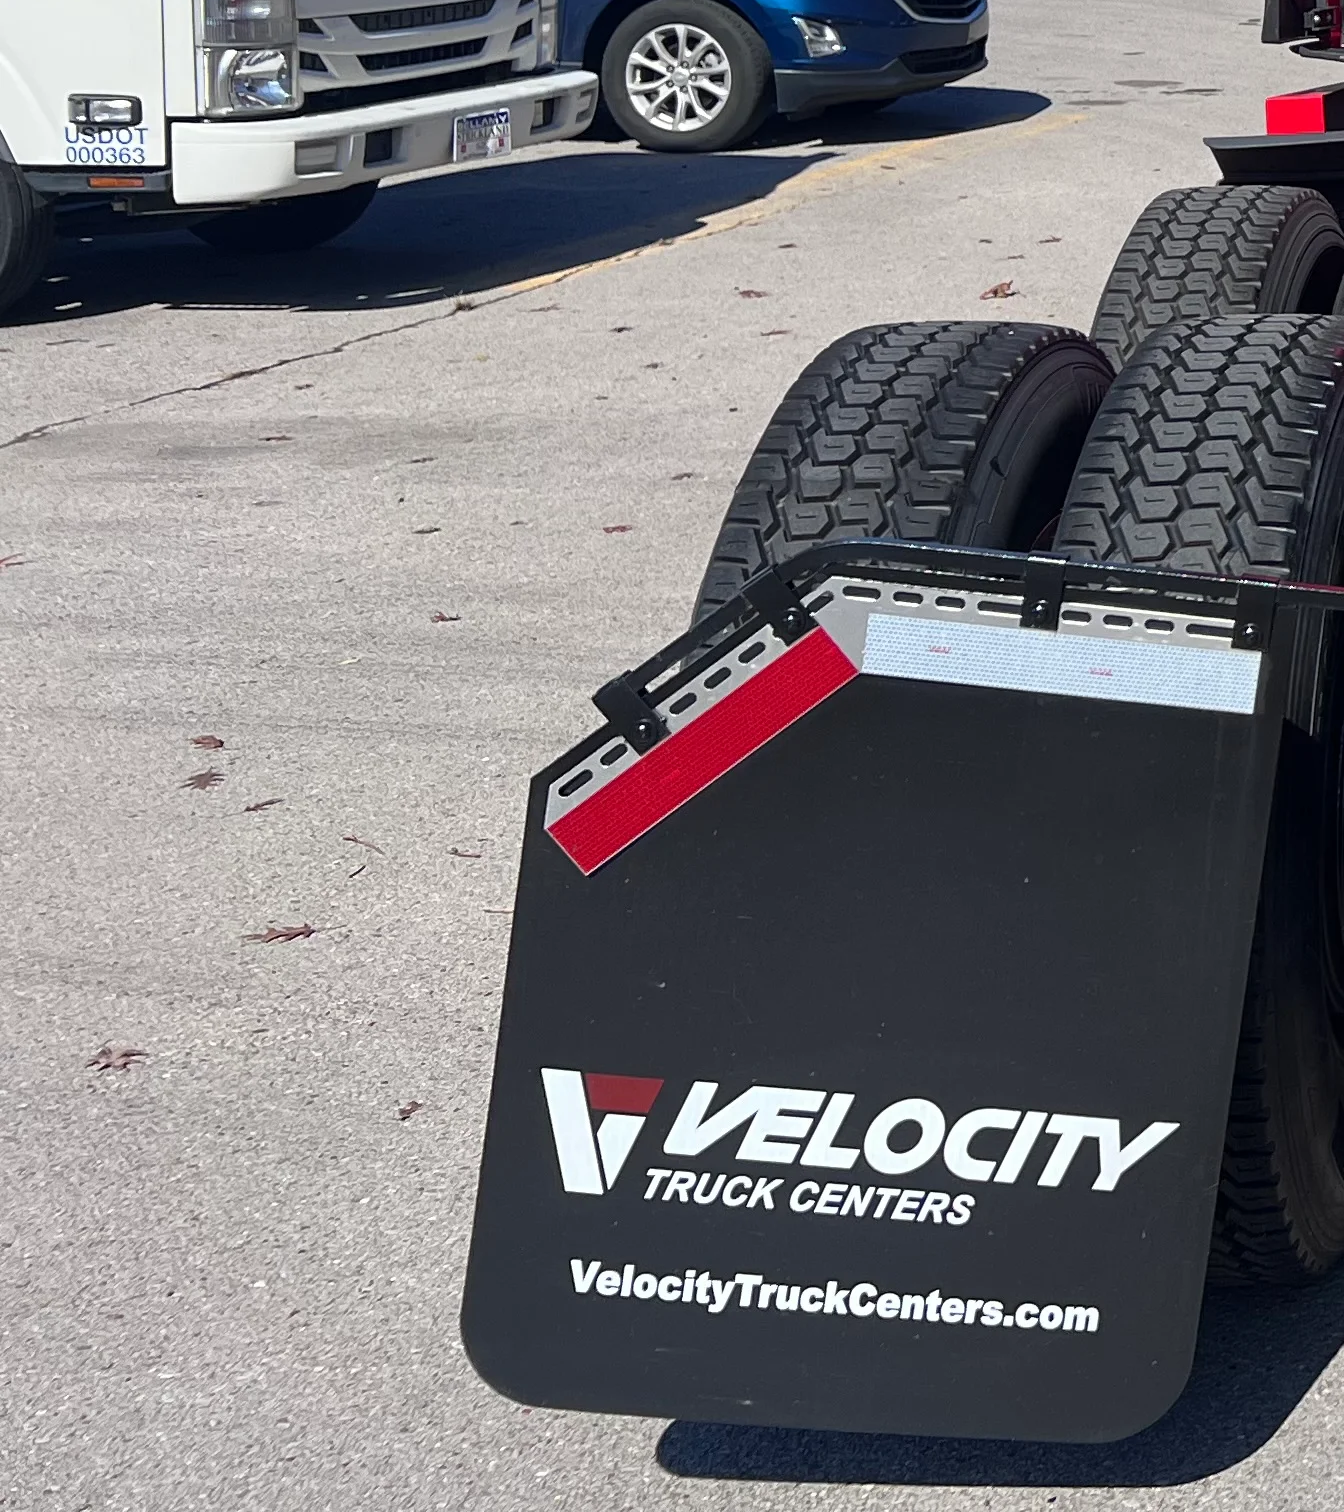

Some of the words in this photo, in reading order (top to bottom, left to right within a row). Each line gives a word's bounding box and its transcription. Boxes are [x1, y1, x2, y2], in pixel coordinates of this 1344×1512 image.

[65, 127, 148, 144] USDOT
[66, 146, 145, 164] 000363
[663, 1080, 1181, 1192] VELOCITY
[643, 1168, 785, 1210] TRUCK
[789, 1180, 976, 1226] CENTERS
[570, 1258, 1100, 1332] VelocityTruckCenters.com
